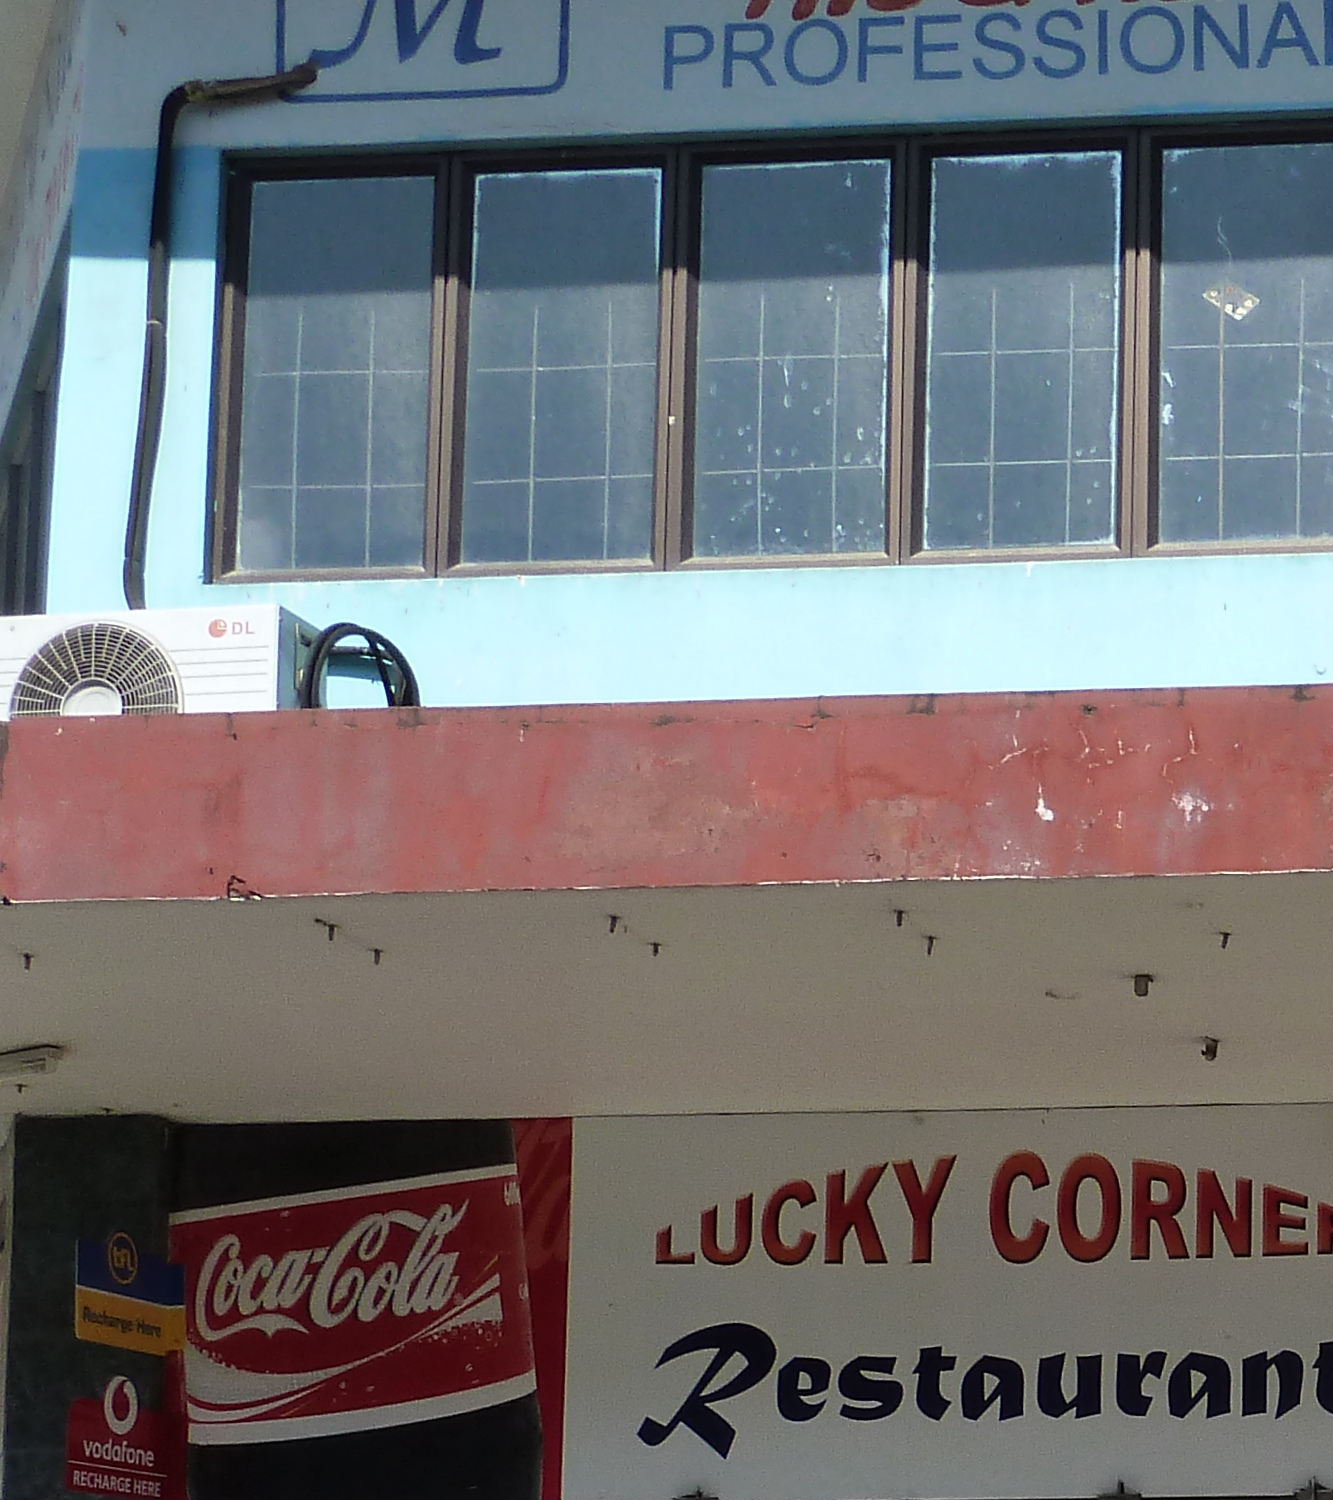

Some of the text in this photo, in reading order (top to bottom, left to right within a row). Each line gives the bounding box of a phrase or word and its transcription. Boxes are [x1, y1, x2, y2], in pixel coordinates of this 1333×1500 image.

[232, 621, 255, 635] DL
[655, 1154, 957, 1265] LUCKY
[195, 1199, 470, 1342] Coca-Cola
[137, 1319, 162, 1338] Here
[83, 1438, 155, 1467] vodafone
[73, 1470, 162, 1498] RECHARGE HERE
